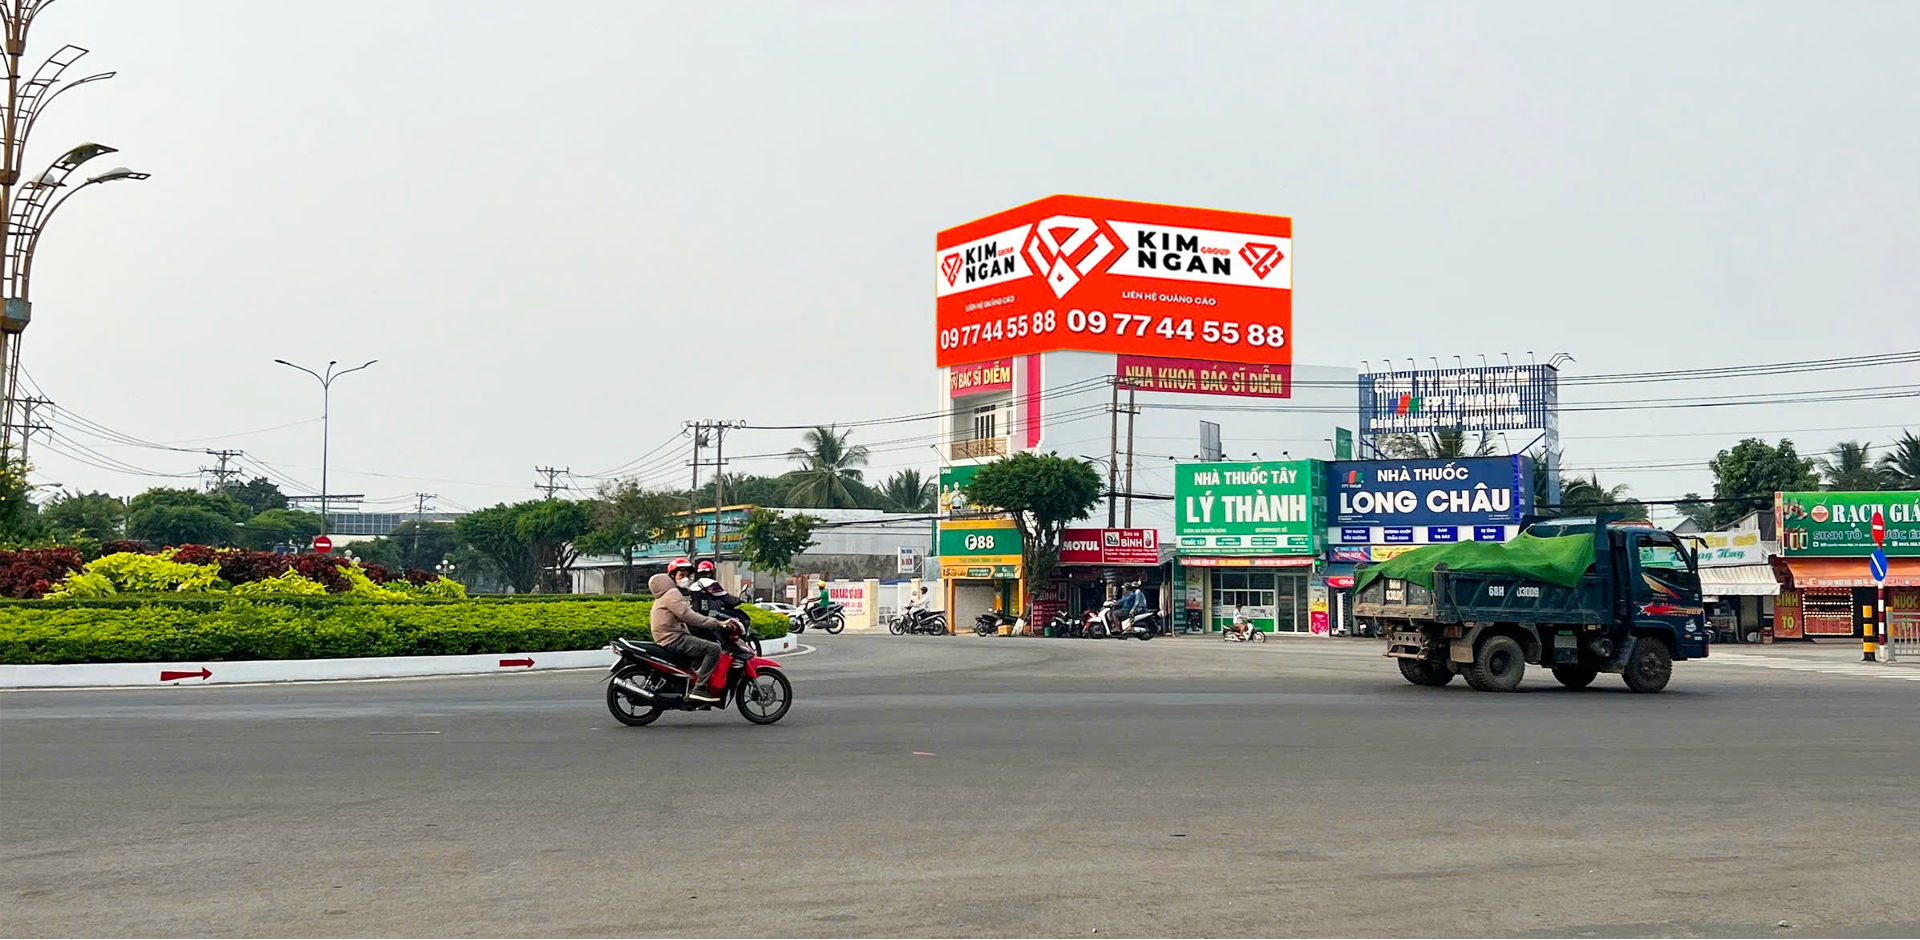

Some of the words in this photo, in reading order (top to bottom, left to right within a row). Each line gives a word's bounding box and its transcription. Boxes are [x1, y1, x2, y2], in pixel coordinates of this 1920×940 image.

[966, 241, 997, 266] KIM
[1138, 230, 1199, 254] KIM
[1200, 246, 1231, 256] GROUP
[966, 255, 1015, 284] NGAN
[1138, 250, 1231, 276] NGAN
[1122, 290, 1144, 300] LIÊN
[940, 327, 959, 350] 09
[961, 324, 981, 346] 77
[982, 319, 1003, 342] 44
[1006, 315, 1028, 339] 55
[1032, 309, 1056, 334] 88
[1067, 310, 1107, 334] 09
[1113, 313, 1152, 337] 77
[1156, 317, 1195, 340] 44
[1202, 321, 1240, 344] 55
[1247, 324, 1285, 348] 88
[959, 369, 972, 389] BÁC
[973, 366, 981, 386] SĨ
[984, 361, 1010, 385] DIỄM
[1126, 366, 1154, 388] NHA
[1158, 368, 1196, 390] KHOA
[1201, 365, 1228, 392] BÁC
[1232, 367, 1246, 393] SĨ
[1251, 365, 1283, 395] DIỄM
[1456, 393, 1520, 411] PHARMA
[1194, 468, 1220, 486] NHÀ
[1224, 466, 1268, 485] THUỐC
[1271, 467, 1297, 484] TÂY
[1377, 465, 1411, 482] NHÀ
[1413, 462, 1469, 481] THUỐC
[1186, 490, 1215, 523] LÝ
[1221, 489, 1307, 523] THÀNH
[1340, 490, 1418, 514] LONG
[1426, 482, 1511, 514] CHÂU
[1889, 498, 1920, 523] GIÁ
[965, 534, 995, 550] F88
[1062, 541, 1100, 551] MOTUL
[1121, 537, 1143, 547] BÌNH
[1813, 530, 1843, 541] SINH
[1883, 529, 1906, 541] ƯỚC
[1488, 586, 1505, 597] 68H
[1776, 594, 1799, 607] SINH
